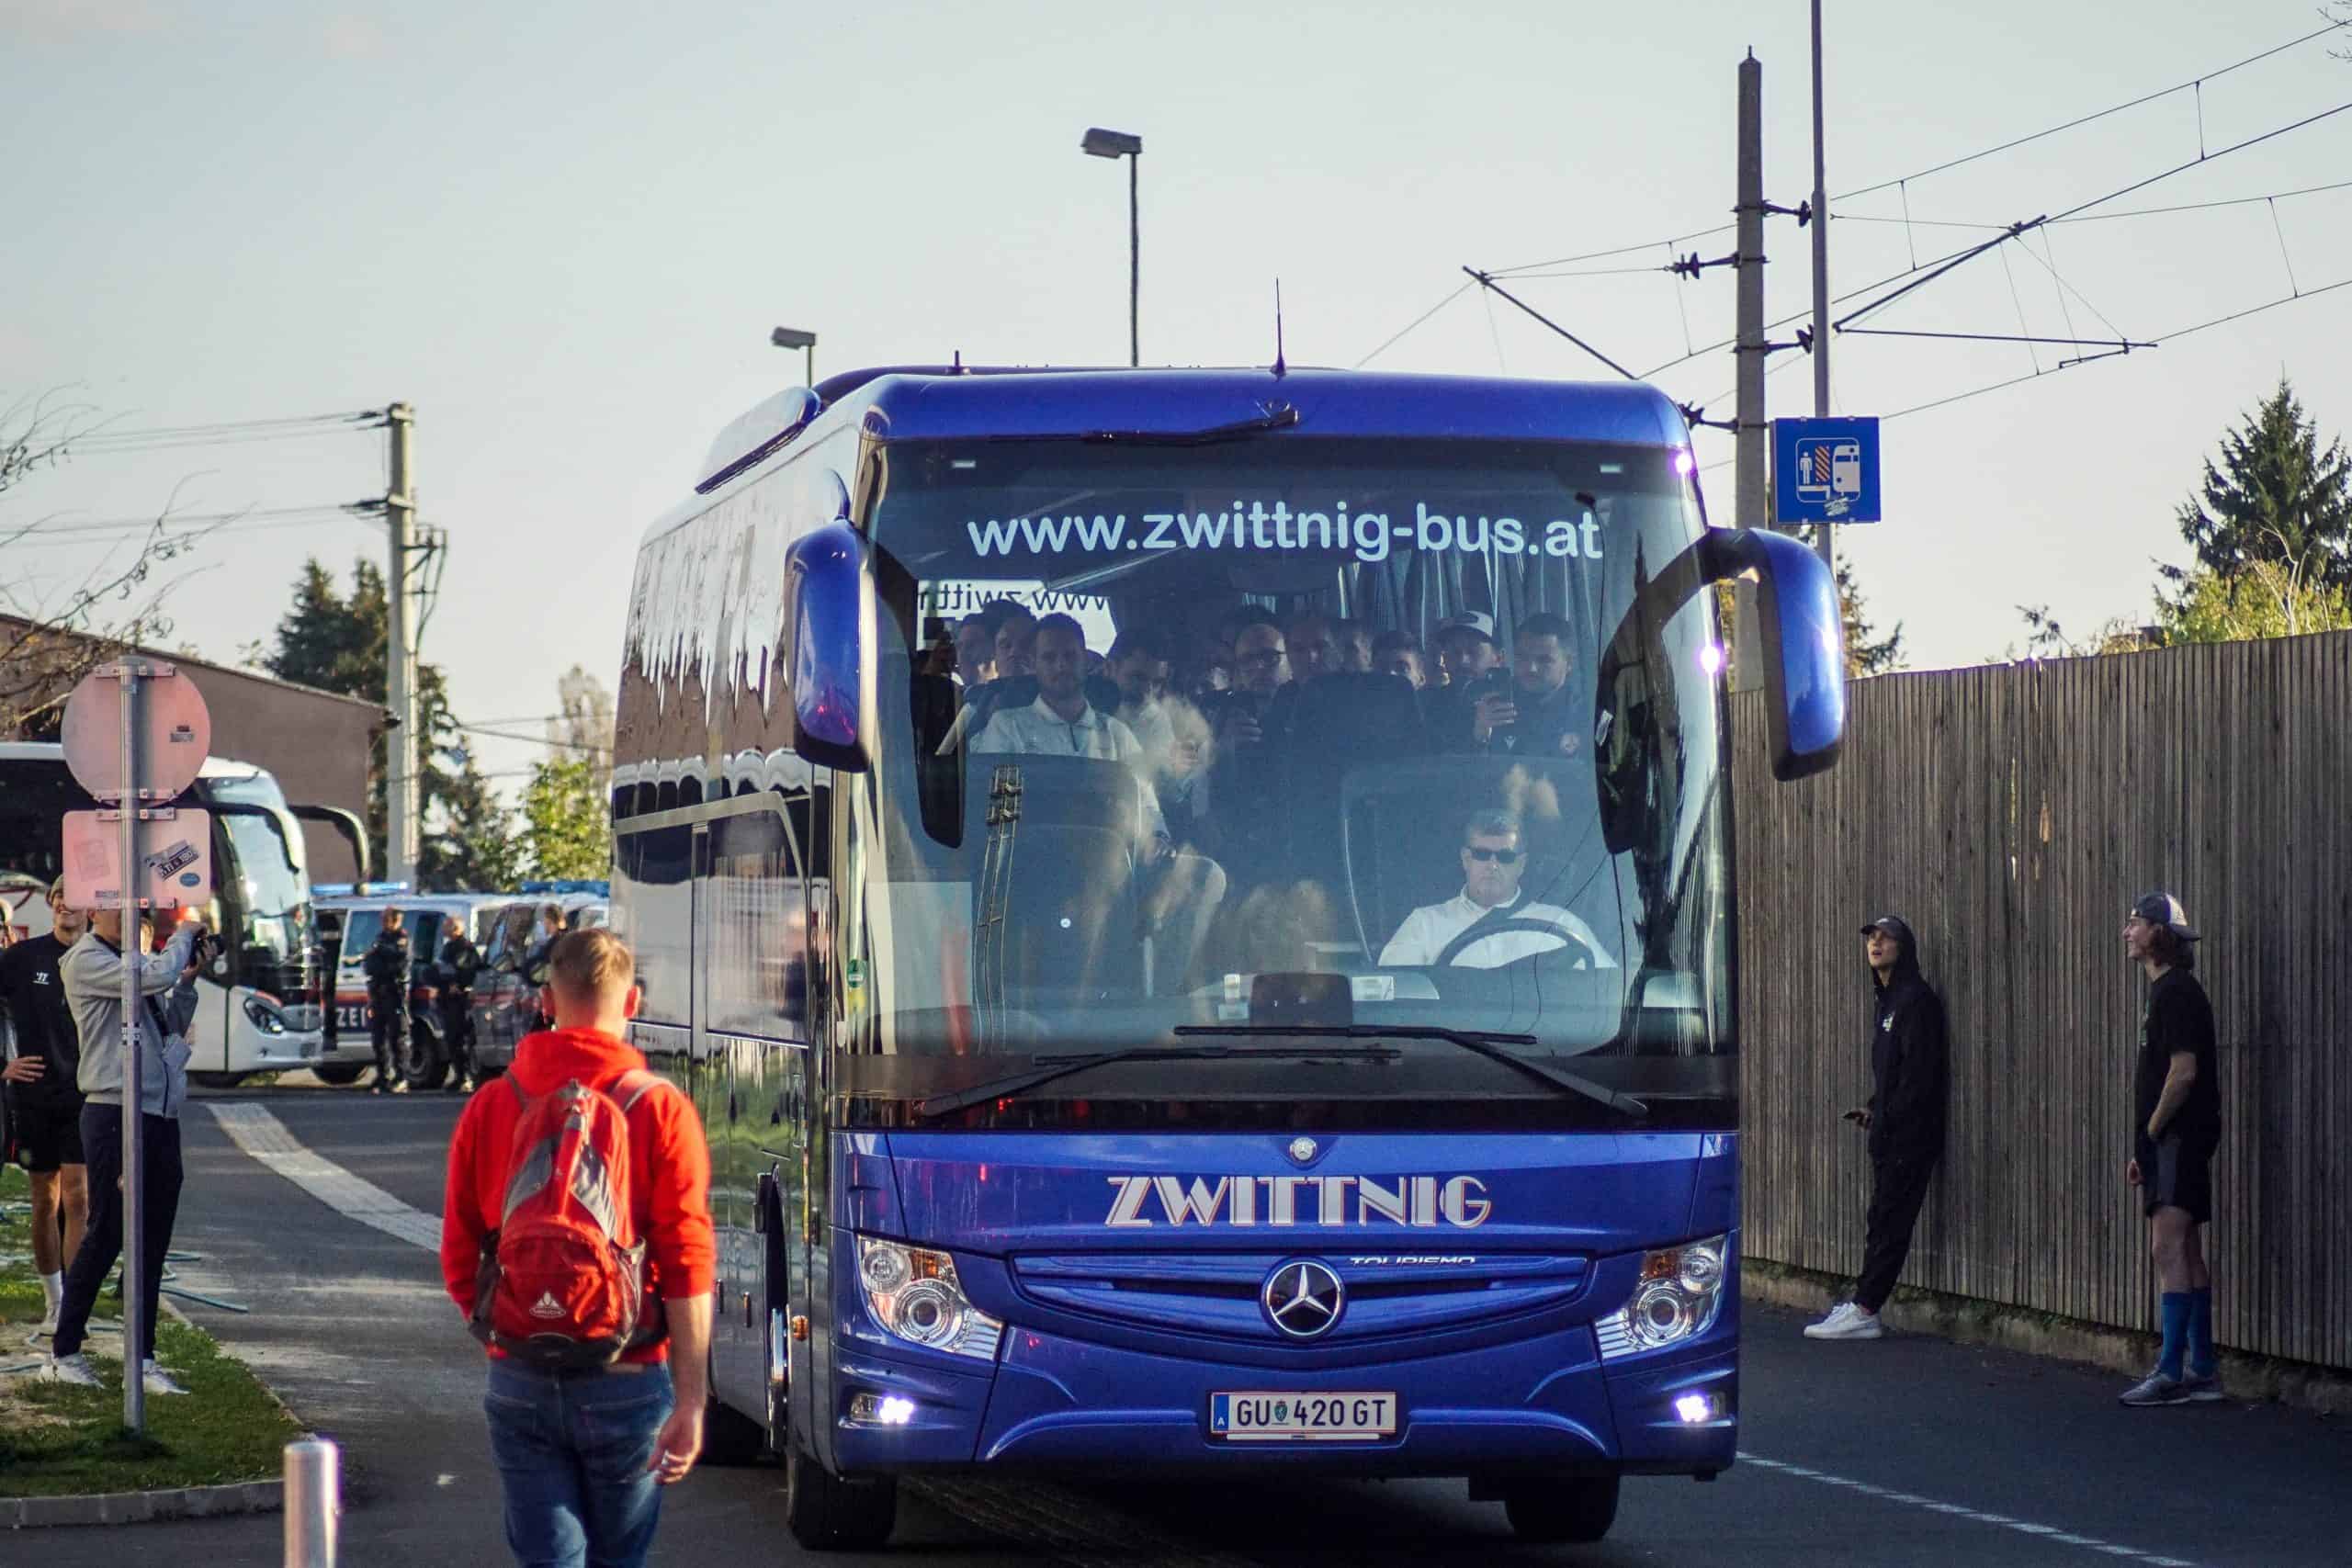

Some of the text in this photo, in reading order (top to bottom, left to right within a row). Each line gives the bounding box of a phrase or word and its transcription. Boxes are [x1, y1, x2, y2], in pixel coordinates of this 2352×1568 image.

[967, 501, 1603, 562] www.zwittnig-bus.at
[1104, 1176, 1492, 1228] ZWITTNIG
[1217, 1417, 1226, 1427] A
[1237, 1400, 1386, 1427] GU 420 GT
